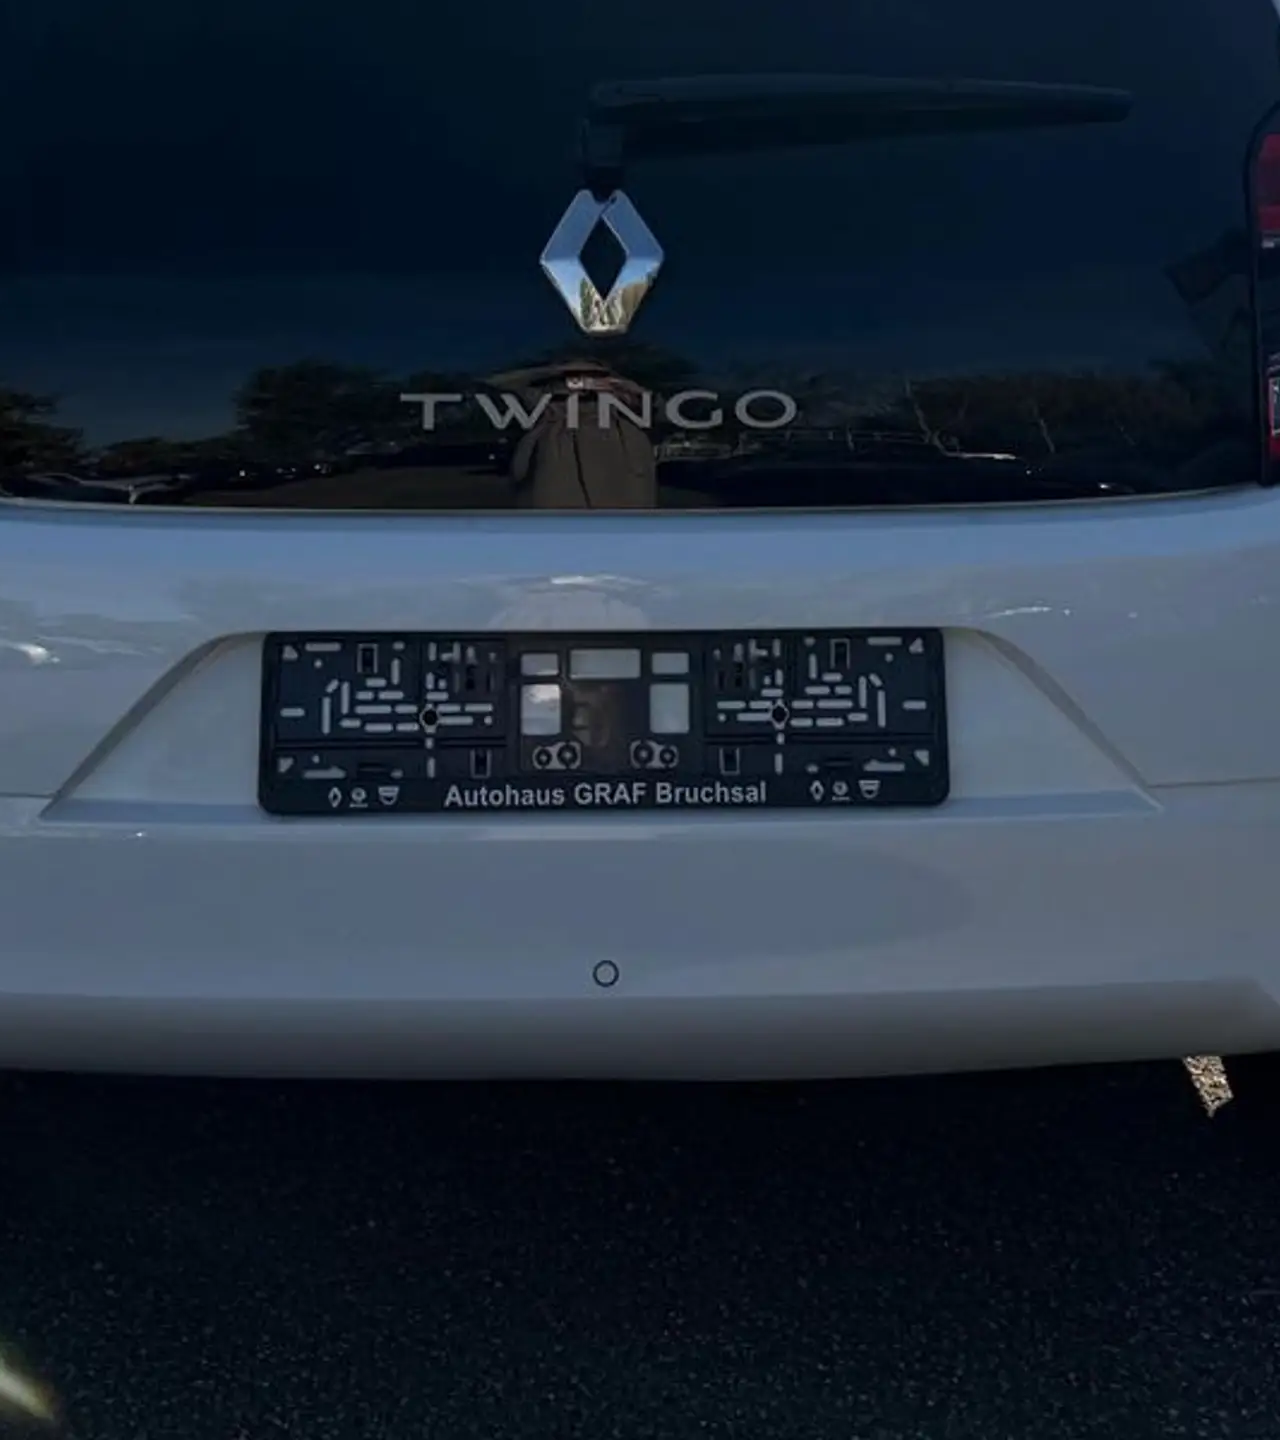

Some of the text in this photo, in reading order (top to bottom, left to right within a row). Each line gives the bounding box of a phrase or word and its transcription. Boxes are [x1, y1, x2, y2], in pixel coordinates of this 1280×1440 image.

[399, 389, 798, 431] TWINGO
[444, 780, 767, 807] Autohaus GRAF Bruchsal
